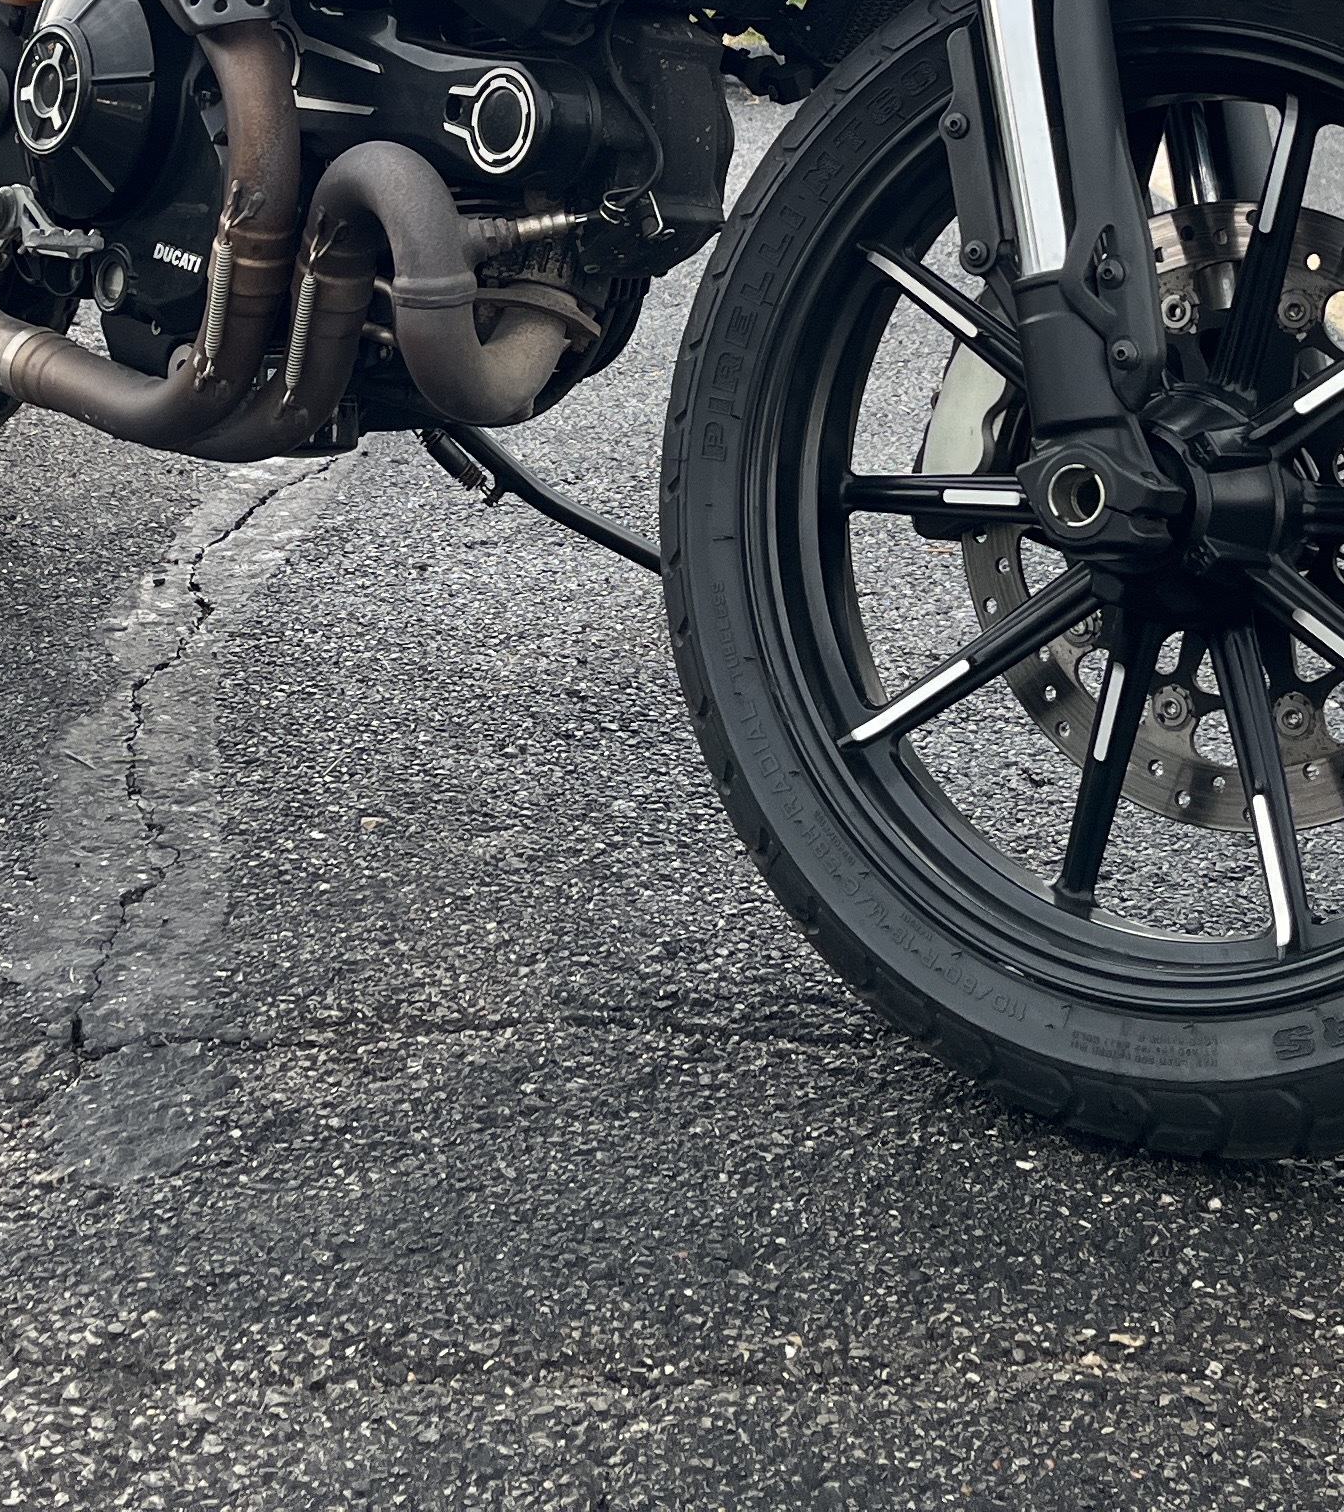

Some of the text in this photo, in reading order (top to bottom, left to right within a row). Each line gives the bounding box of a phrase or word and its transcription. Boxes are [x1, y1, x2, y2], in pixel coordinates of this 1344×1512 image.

[152, 242, 203, 274] DUCATI
[697, 53, 942, 463] PIRELLI MT60
[731, 695, 807, 825] RADIAL
